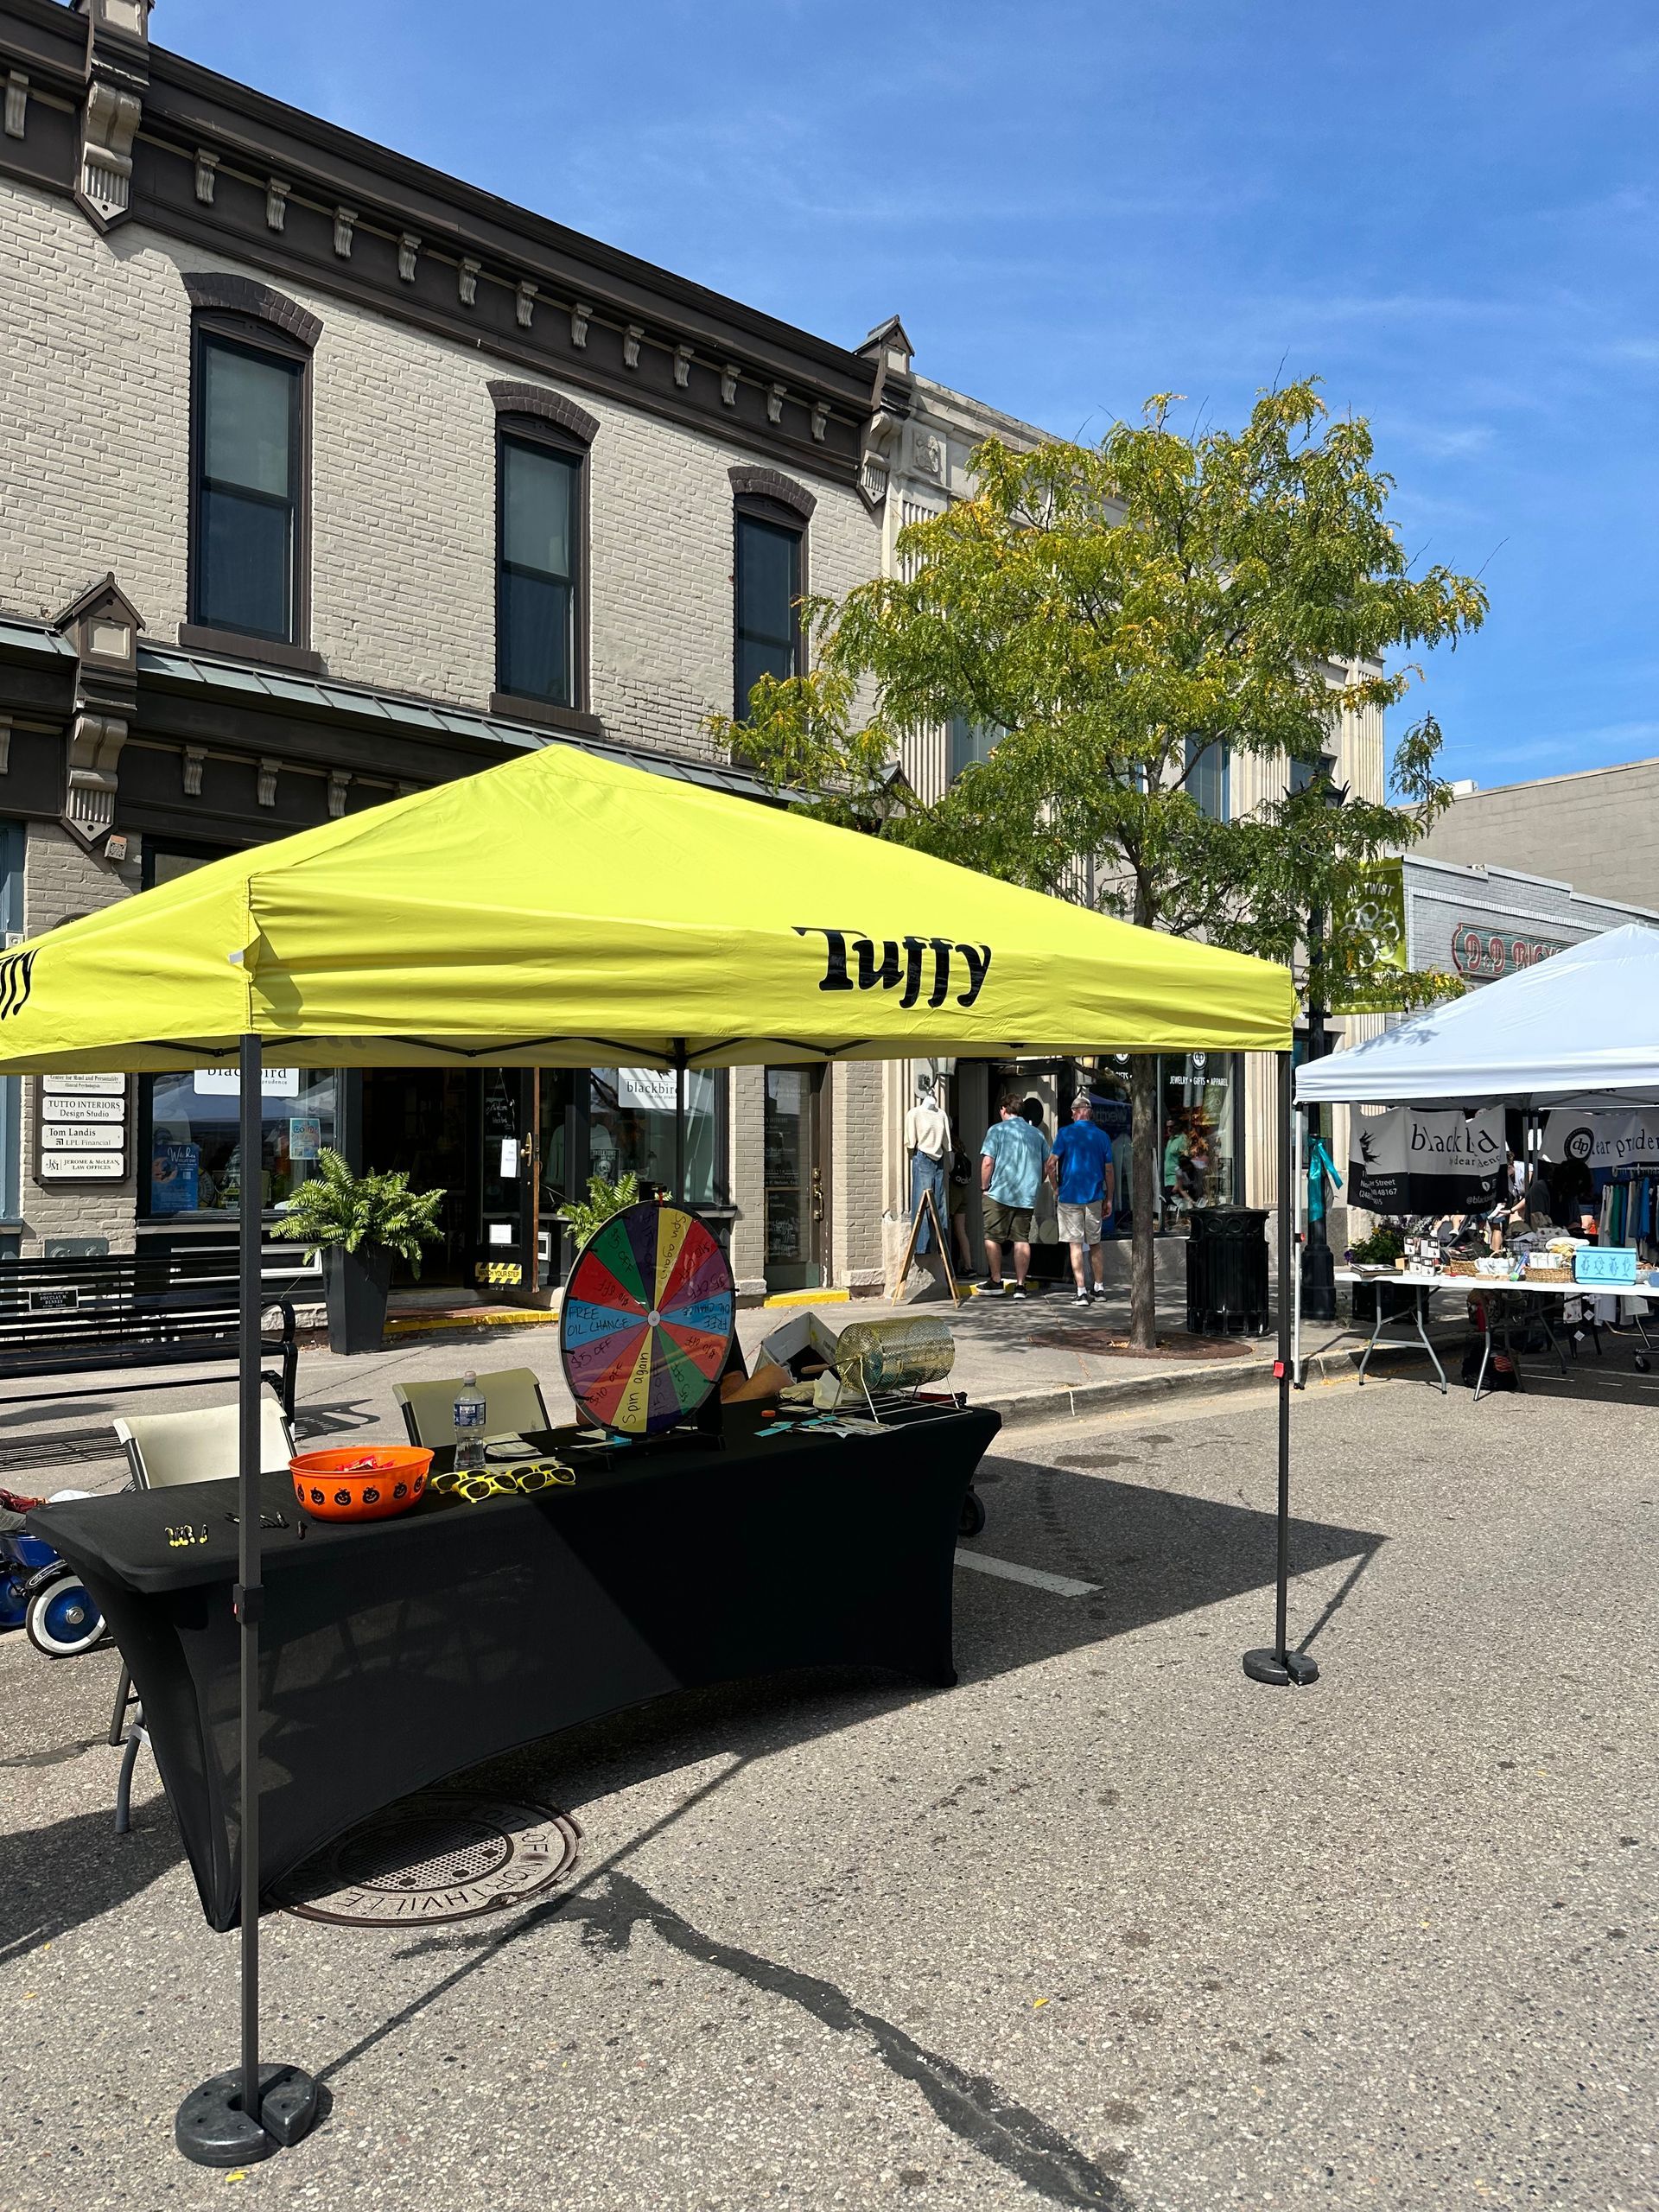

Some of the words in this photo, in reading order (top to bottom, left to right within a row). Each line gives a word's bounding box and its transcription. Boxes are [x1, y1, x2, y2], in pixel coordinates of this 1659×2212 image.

[1363, 882, 1395, 897] TWIST
[791, 926, 992, 1008] Tuffy
[1511, 940, 1564, 971] BICY
[0, 944, 46, 1020] ffy
[207, 1069, 287, 1078] blacird
[1169, 1076, 1188, 1085] JEWELRY
[1193, 1077, 1205, 1085] GIFTS
[1211, 1077, 1229, 1087] APPAREL
[60, 1109, 85, 1118] Design
[78, 1101, 120, 1109] INTERIORS
[1410, 1123, 1500, 1156] blackbd
[671, 1211, 688, 1238] Spin
[660, 1243, 676, 1280] again
[568, 1305, 600, 1320] FREE
[703, 1314, 728, 1331] FREE
[567, 1324, 586, 1337] OIL
[589, 1318, 631, 1332] CHANGE
[570, 1351, 593, 1370] $5
[594, 1337, 612, 1356] OFF
[589, 1386, 607, 1406] $10
[608, 1362, 624, 1383] OFF
[622, 1391, 640, 1425] Spin
[633, 1351, 650, 1384] again
[521, 1832, 549, 1853] OF
[334, 1861, 548, 1912] NORTHVILLE
